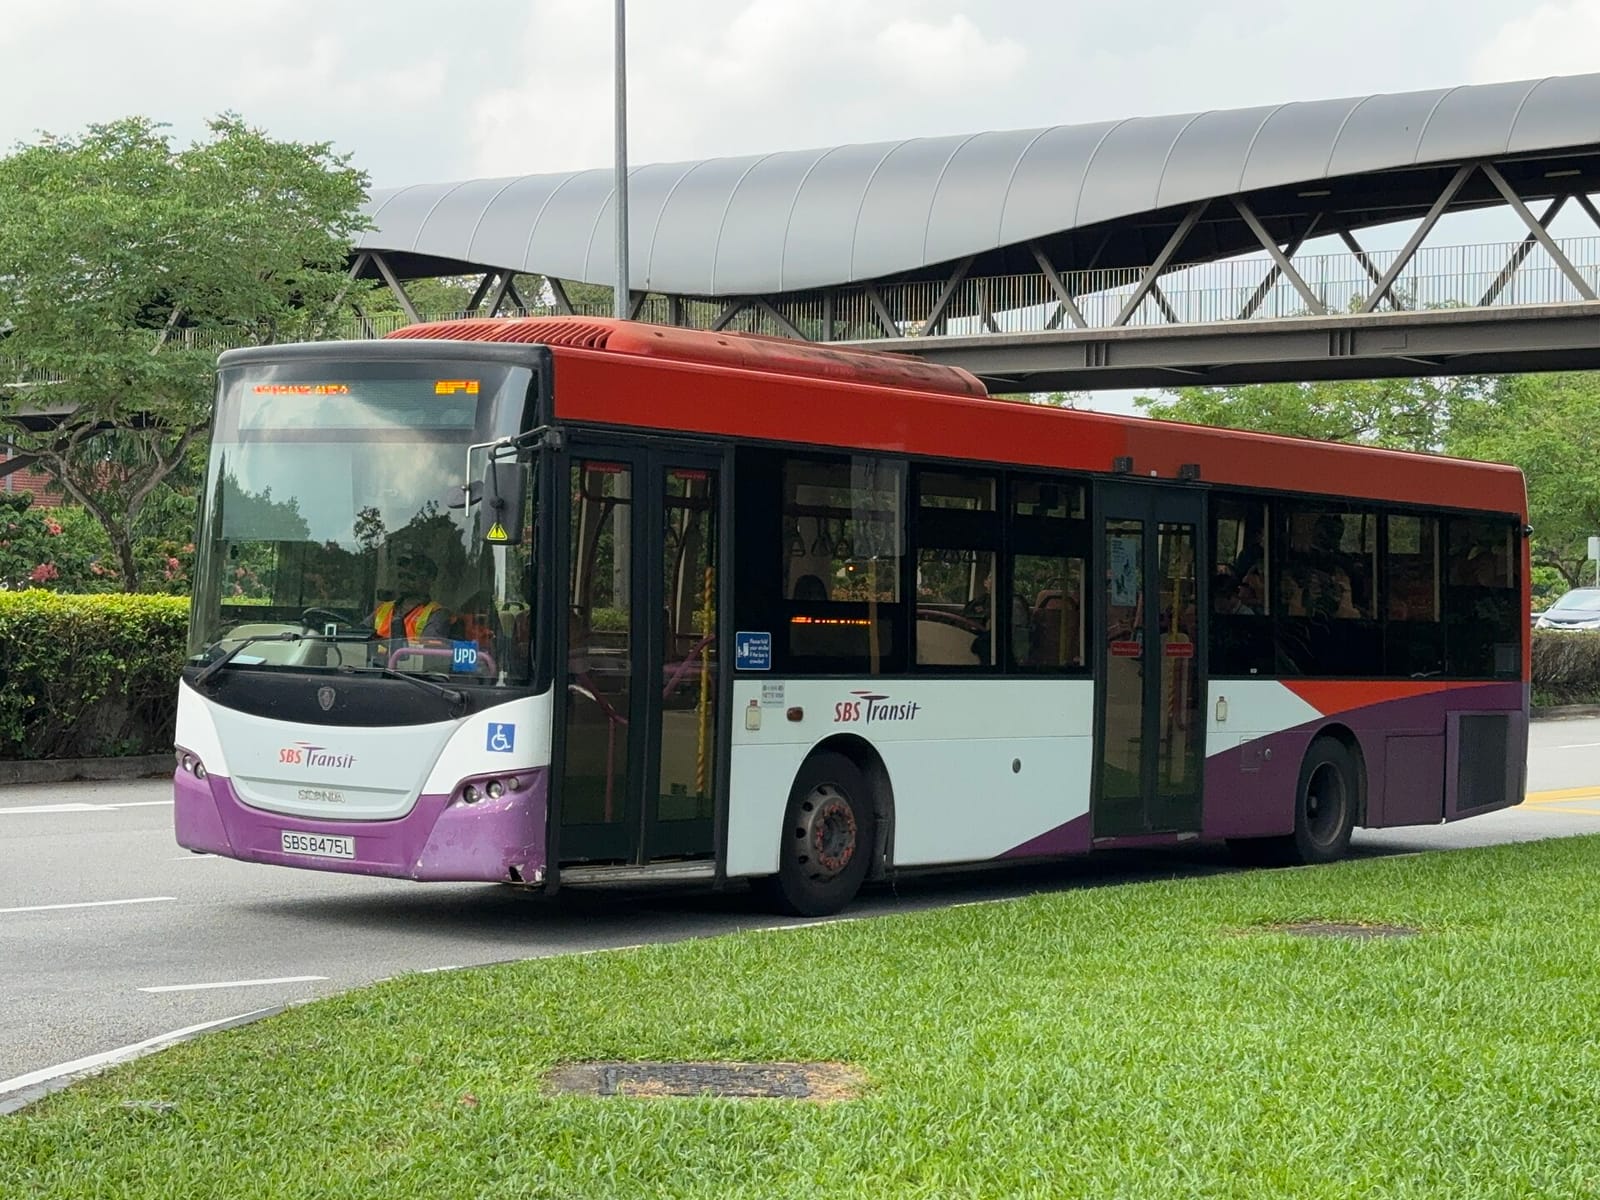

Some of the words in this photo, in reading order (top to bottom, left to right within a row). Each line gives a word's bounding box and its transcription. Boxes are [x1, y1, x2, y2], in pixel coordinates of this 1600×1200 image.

[454, 647, 477, 664] UPD
[833, 701, 861, 722] SBS
[859, 695, 922, 725] Transit
[279, 748, 302, 764] SBS
[300, 746, 358, 769] Transit
[283, 834, 353, 855] SBS8475L
